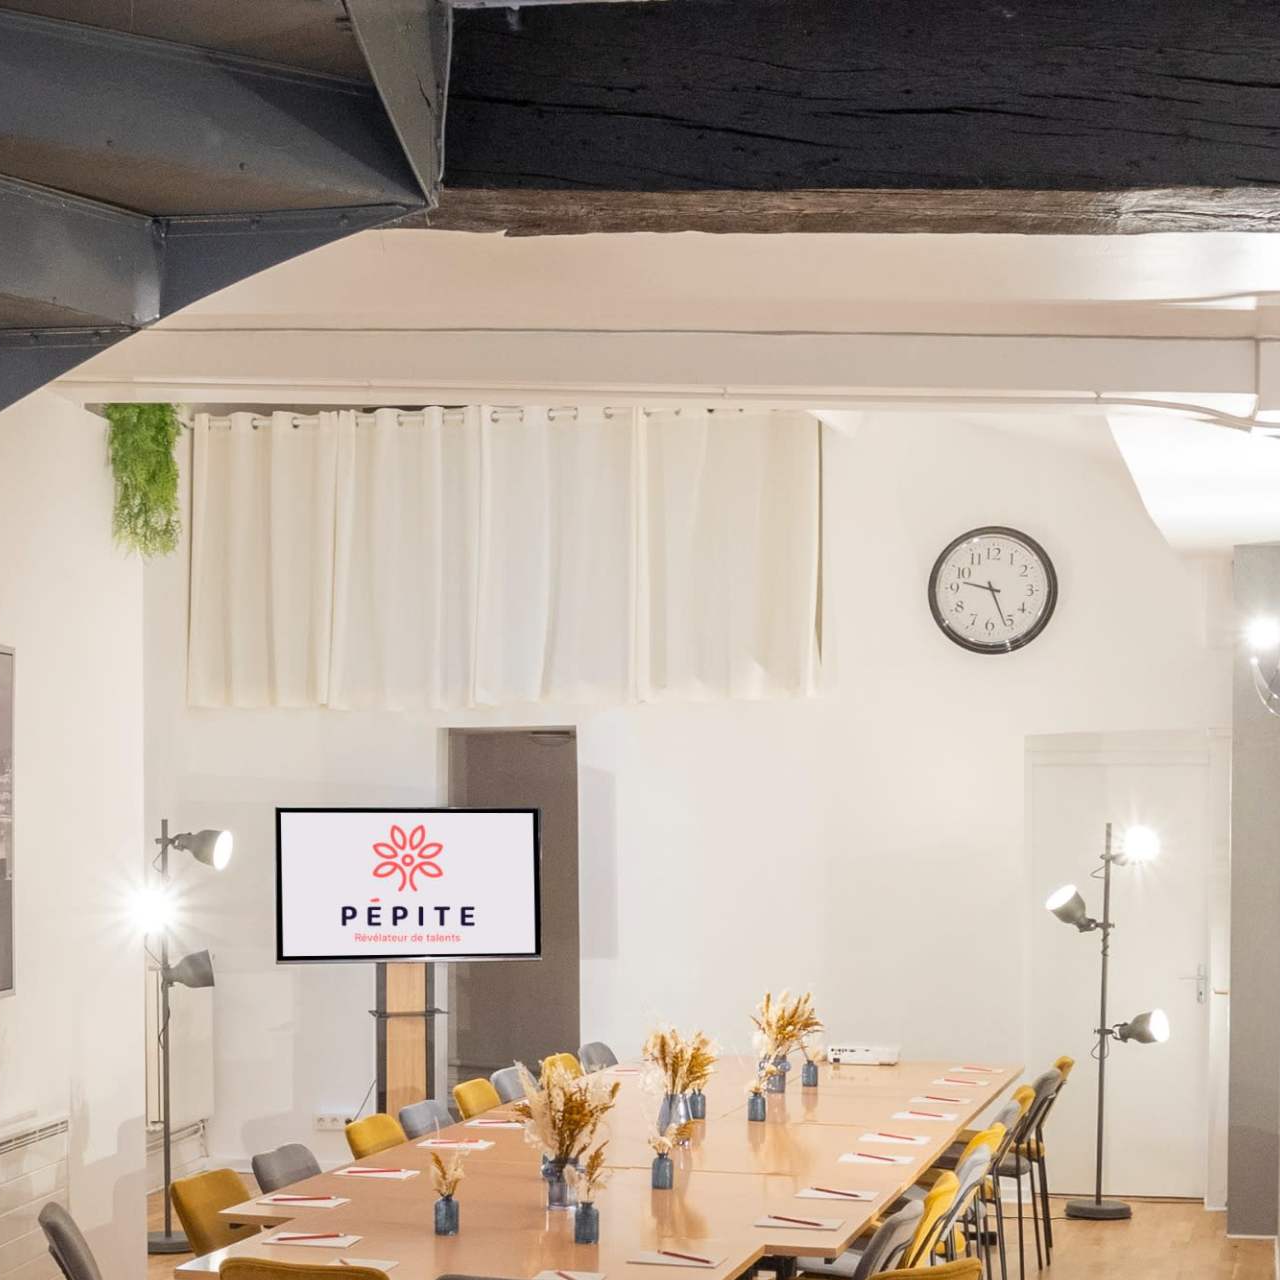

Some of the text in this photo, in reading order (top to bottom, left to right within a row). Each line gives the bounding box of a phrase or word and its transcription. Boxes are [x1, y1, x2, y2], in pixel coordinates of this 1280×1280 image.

[970, 553, 981, 565] 11
[987, 547, 1001, 561] 12
[957, 567, 971, 579] 10
[1020, 565, 1029, 577] 2
[950, 582, 960, 593] 9
[1026, 584, 1034, 597] 3
[955, 601, 965, 613] 8
[1017, 602, 1026, 614] 4
[970, 613, 978, 626] 7
[985, 618, 995, 631] 6
[1006, 615, 1014, 627] 5
[340, 897, 475, 926] PÉPITE
[354, 933, 461, 943] Révélateur de talents
